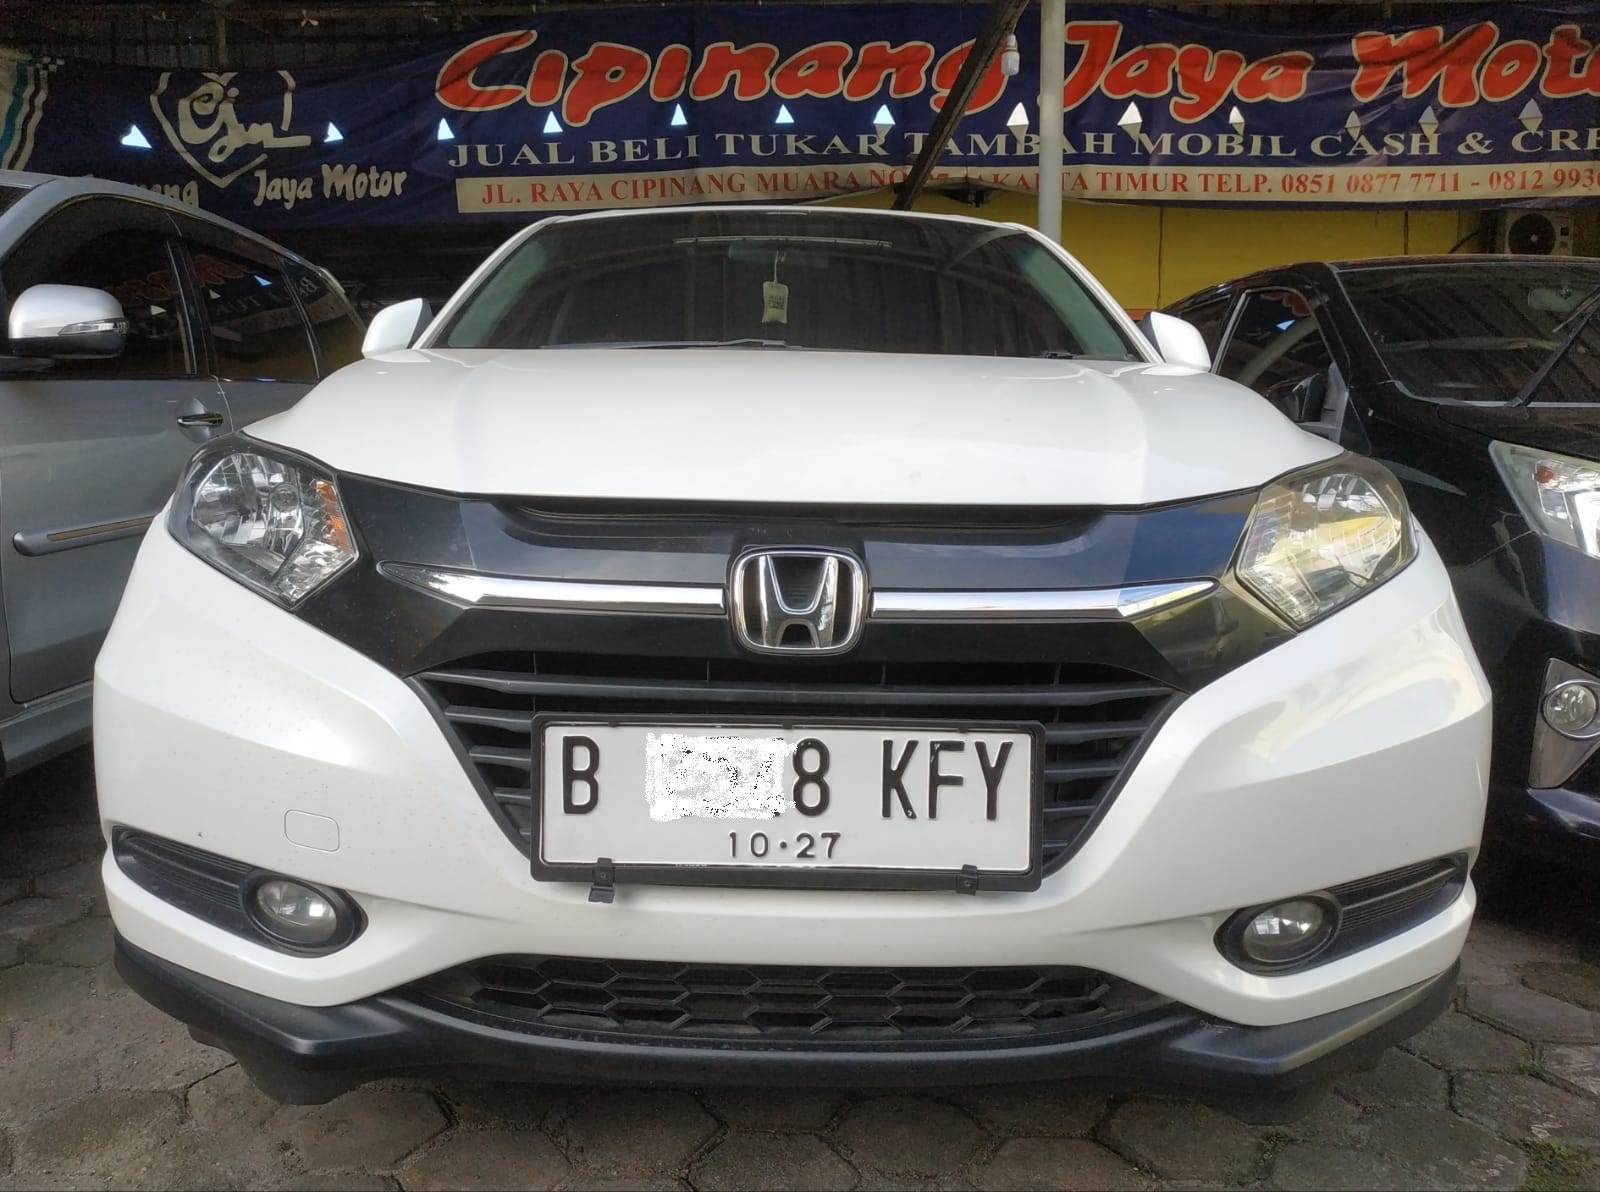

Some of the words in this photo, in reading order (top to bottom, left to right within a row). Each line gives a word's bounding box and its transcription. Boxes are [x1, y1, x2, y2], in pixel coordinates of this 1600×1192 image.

[435, 30, 1011, 127] Cipinang
[1037, 20, 1314, 123] Jaya
[1351, 20, 1600, 108] Mot
[449, 142, 576, 168] JUAL
[588, 135, 701, 164] BELI
[715, 133, 891, 156] TUKAR
[1131, 132, 1297, 157] MOBIL
[1310, 132, 1441, 157] CASH
[1457, 132, 1494, 155] &
[253, 169, 313, 209] Jaya
[321, 163, 407, 201] Motor
[482, 183, 521, 205] JL.
[530, 180, 603, 203] RAYA
[610, 172, 746, 201] CIPINANG
[757, 170, 860, 193] MUARA
[1096, 171, 1189, 193] TIMUR
[1198, 172, 1273, 193] TELP.
[1281, 173, 1336, 194] 0851
[1346, 172, 1401, 194] 0877
[1409, 171, 1461, 193] 7711
[1488, 169, 1544, 191] 0812
[1552, 167, 1600, 189] 993
[562, 735, 600, 816] B
[881, 739, 1014, 820] KFY
